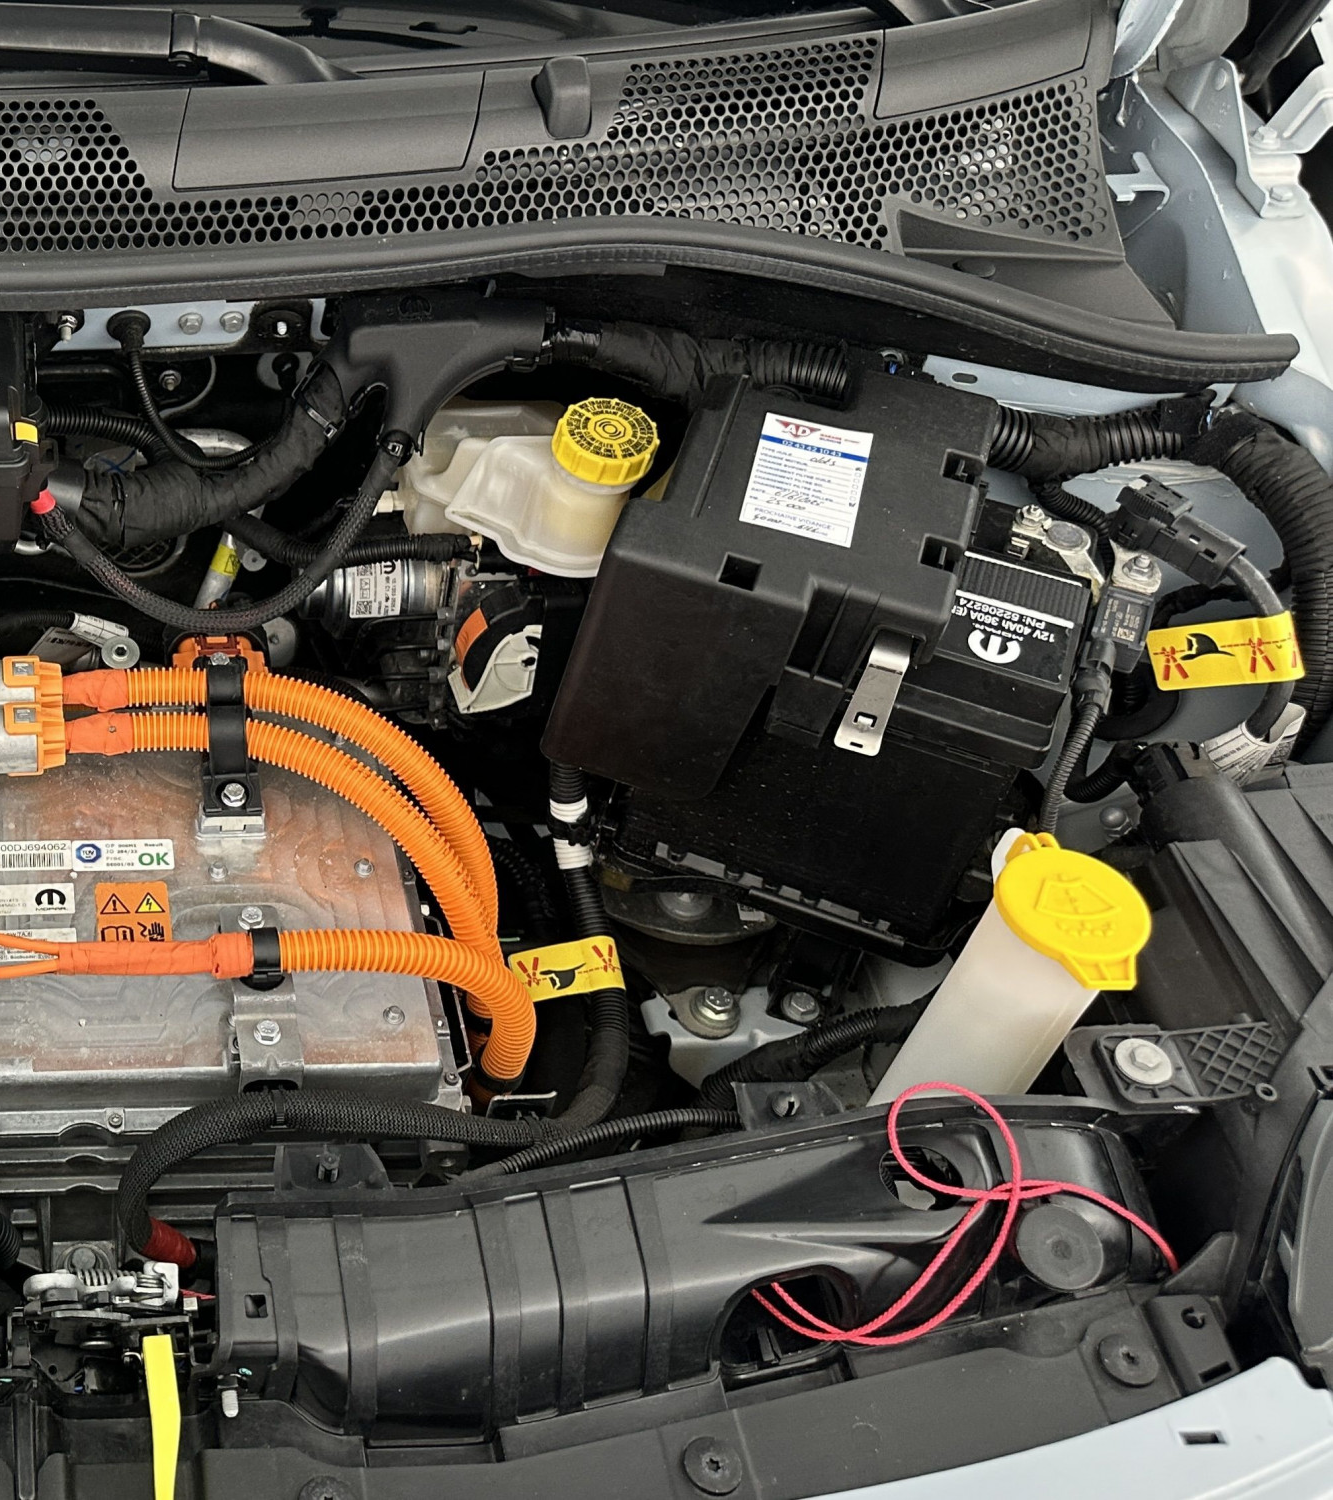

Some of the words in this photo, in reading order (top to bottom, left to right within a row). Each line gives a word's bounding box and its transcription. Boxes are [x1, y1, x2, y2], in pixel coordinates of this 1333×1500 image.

[782, 423, 811, 440] AD
[819, 447, 830, 455] 10
[753, 507, 797, 521] PROCHAINE
[958, 597, 1020, 621] 52206274
[969, 610, 999, 625] 360A
[1021, 615, 1045, 628] PN:
[1000, 620, 1031, 636] 40Ah
[1032, 629, 1055, 642] 12V
[138, 852, 170, 866] OK
